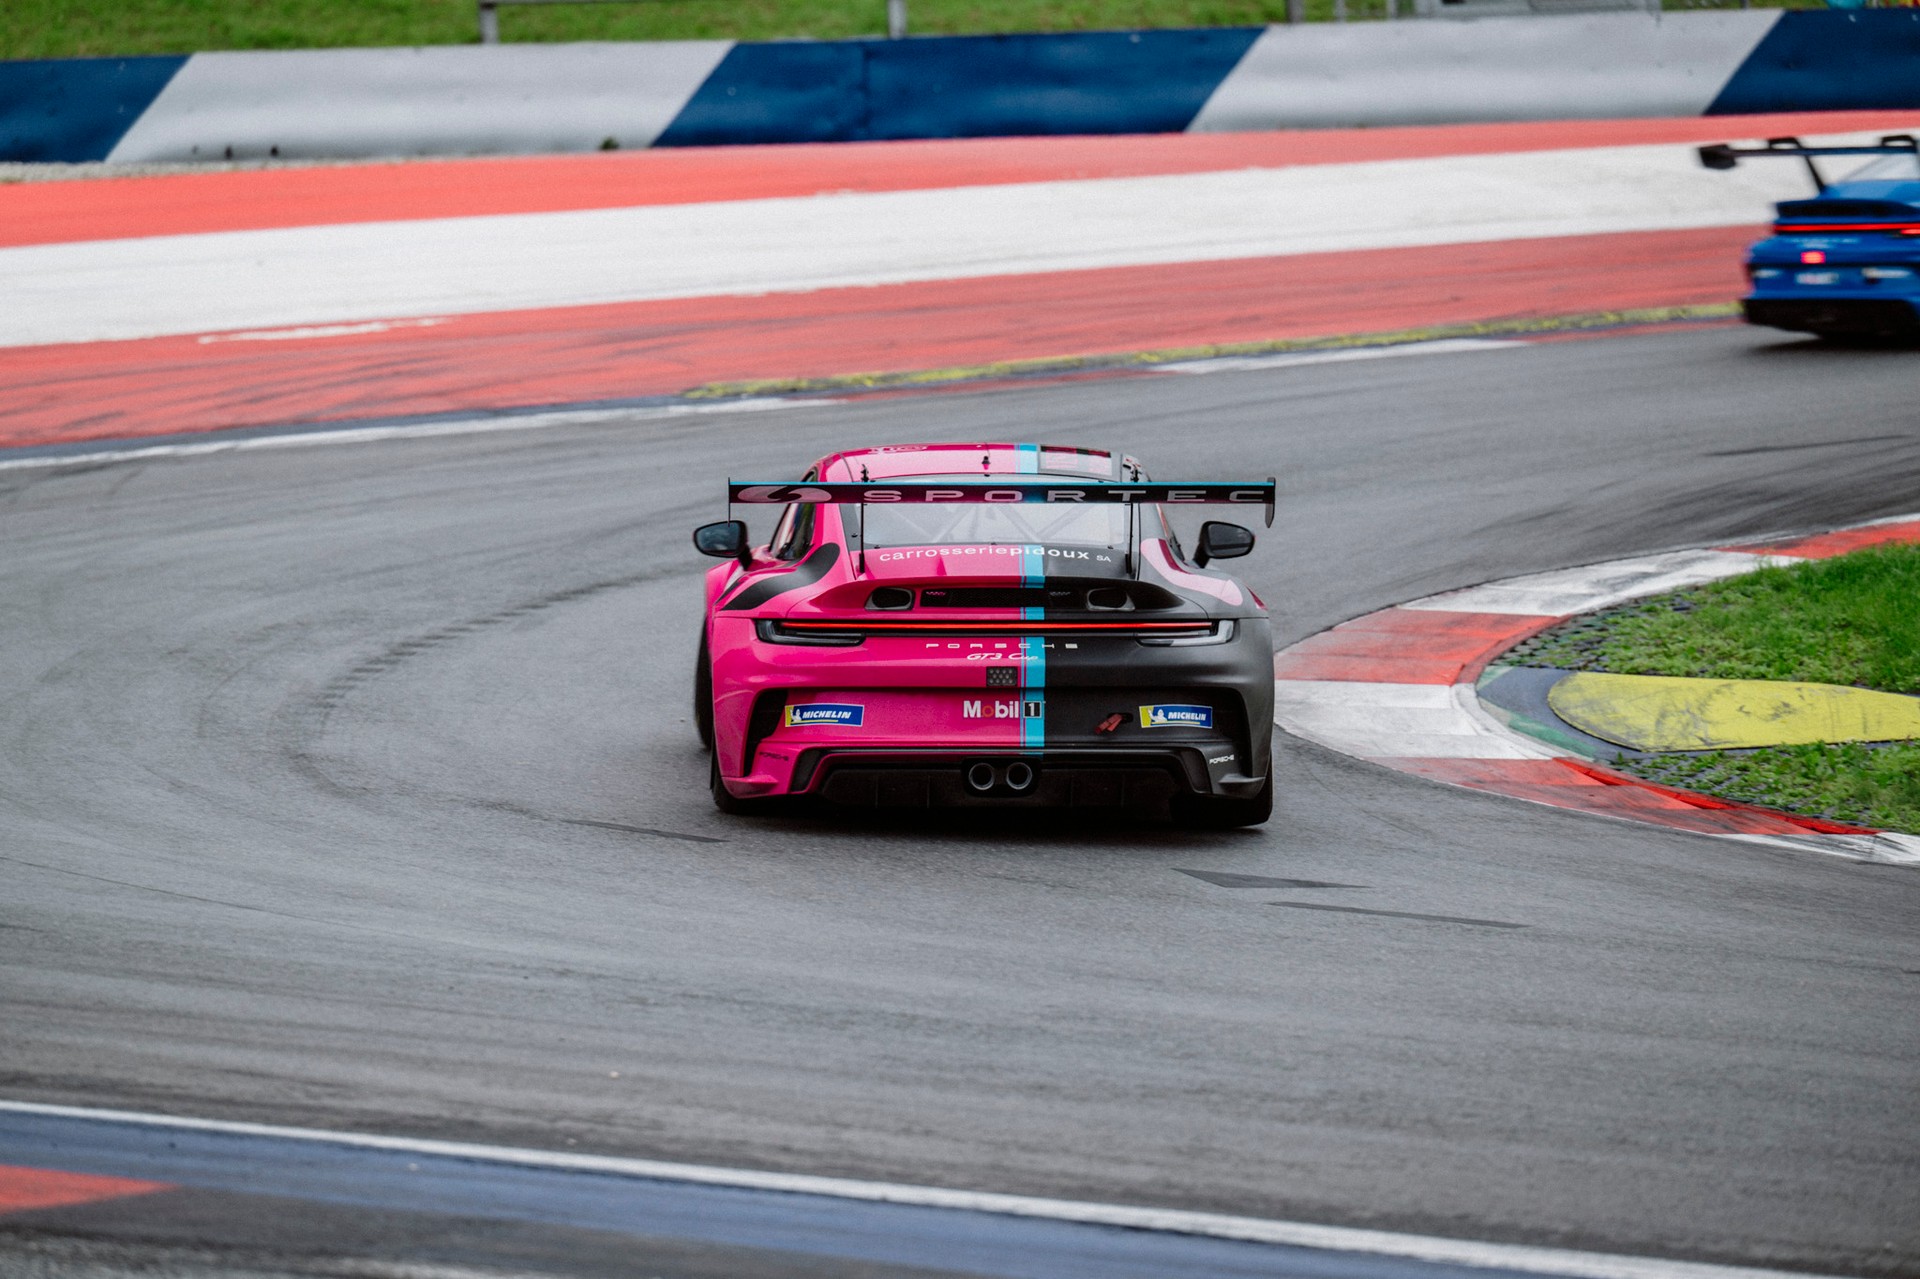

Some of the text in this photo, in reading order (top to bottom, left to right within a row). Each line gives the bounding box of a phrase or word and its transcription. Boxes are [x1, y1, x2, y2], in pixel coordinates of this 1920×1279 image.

[863, 490, 1265, 502] SPORTEC
[879, 546, 1112, 563] carrosseriepidoux SA
[966, 652, 1039, 661] GT3 Cup
[802, 710, 852, 719] MICHELIN
[963, 700, 1019, 719] Mobil
[1167, 711, 1207, 721] MICHELIN
[1209, 754, 1235, 764] PORSCHE
